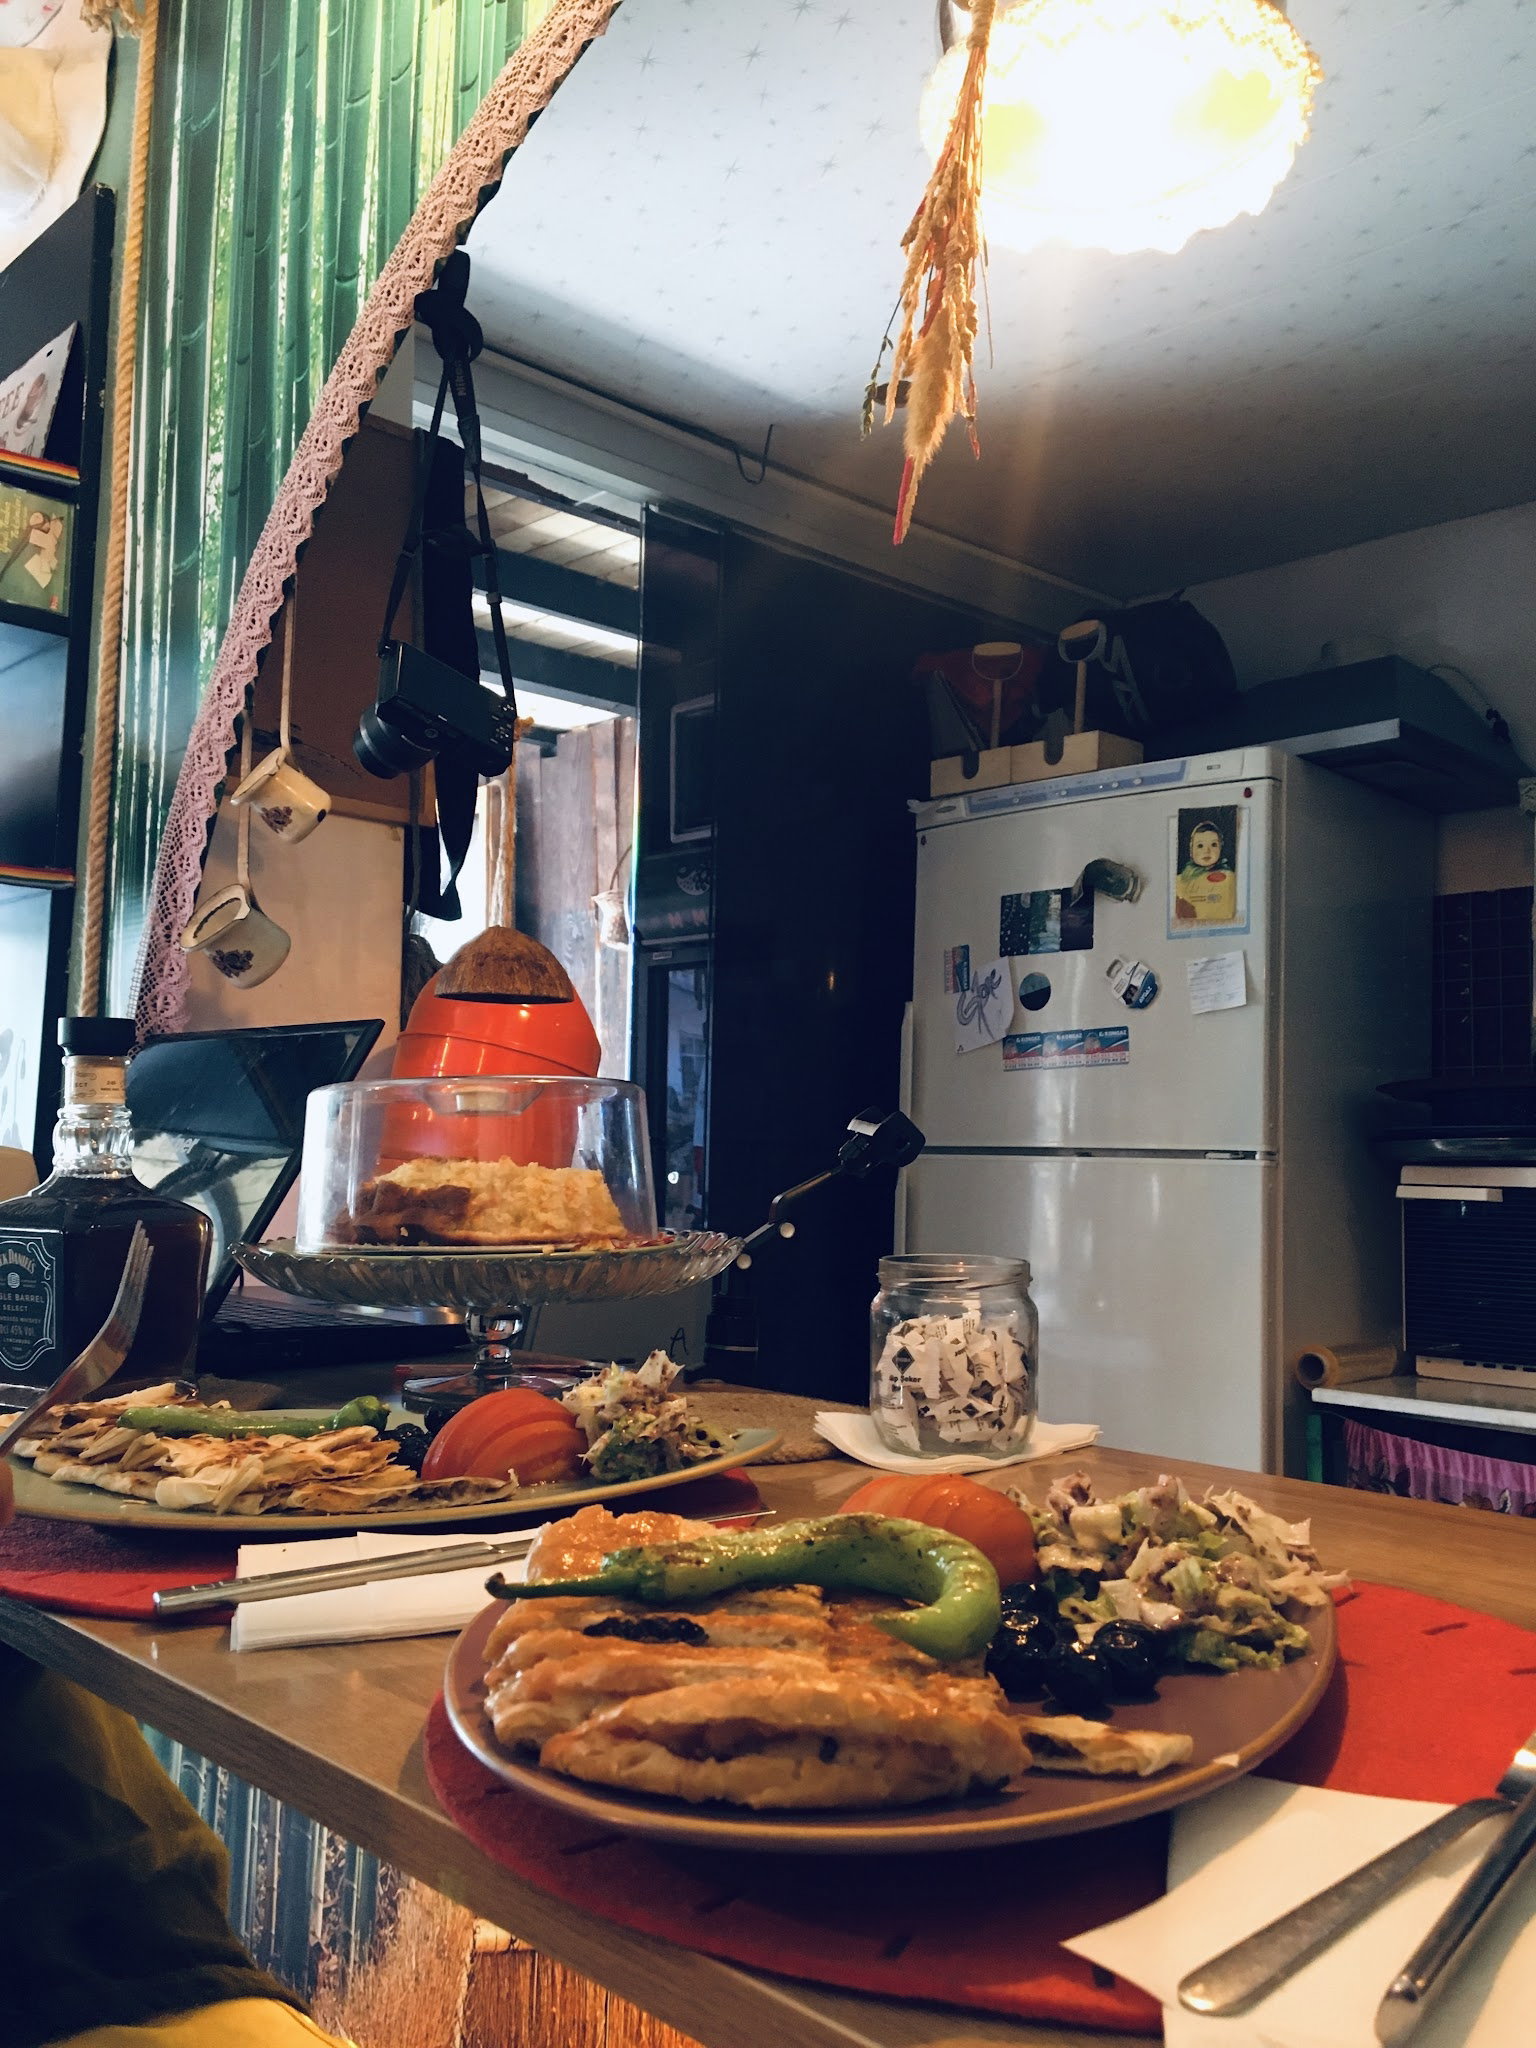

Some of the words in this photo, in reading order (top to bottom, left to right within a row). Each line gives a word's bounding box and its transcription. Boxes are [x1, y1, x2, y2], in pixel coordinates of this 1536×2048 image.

[15, 1294, 45, 1303] BARREL
[3, 1304, 28, 1312] SELECT
[670, 1328, 688, 1357] A
